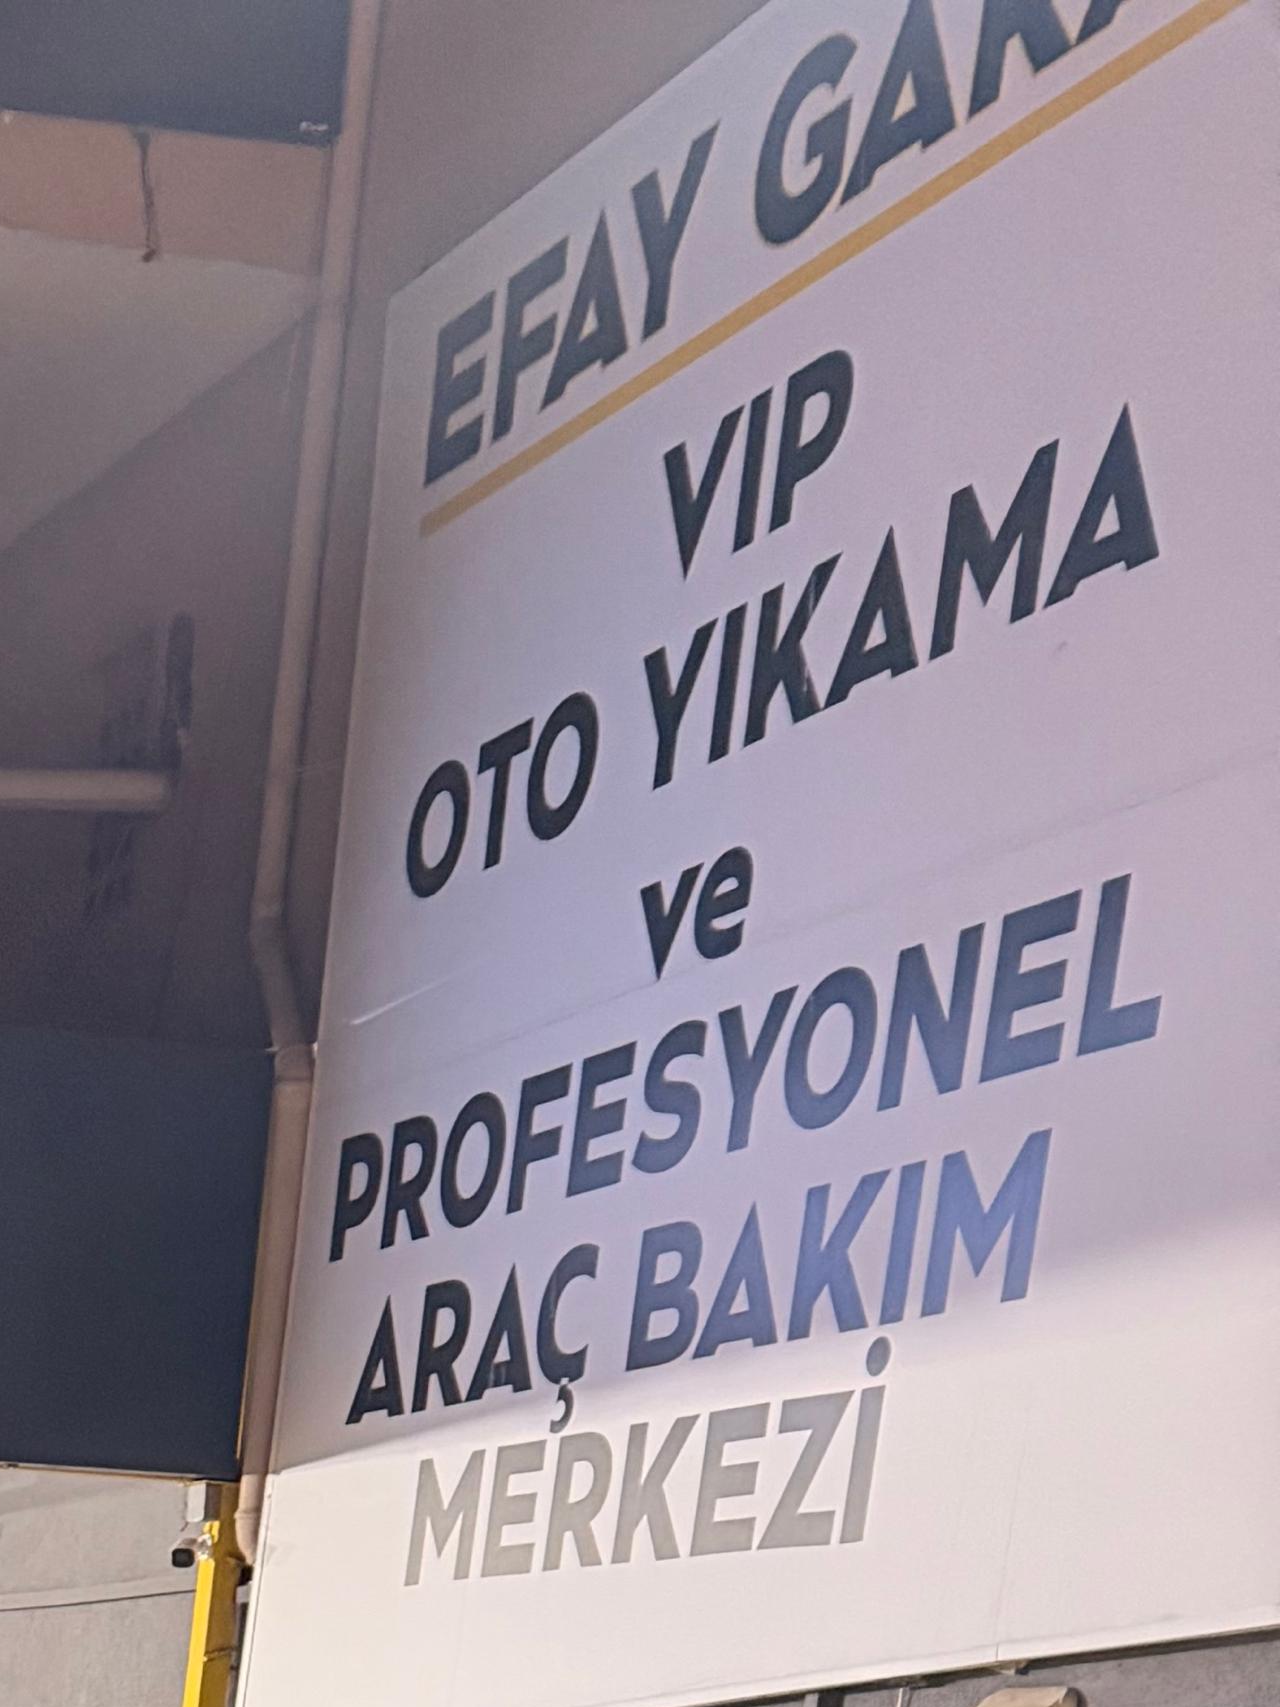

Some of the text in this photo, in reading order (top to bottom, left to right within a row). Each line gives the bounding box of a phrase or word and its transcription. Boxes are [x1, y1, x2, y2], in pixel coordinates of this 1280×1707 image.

[425, 121, 720, 488] EFAY
[663, 350, 854, 580] VIP
[407, 402, 1160, 897] OTO YIKAMA
[641, 847, 753, 980] ve
[329, 874, 1163, 1262] PROFESYONEL
[346, 1128, 1052, 1433] ARAÇ BAKIM
[405, 1337, 891, 1586] MERKEZİ
